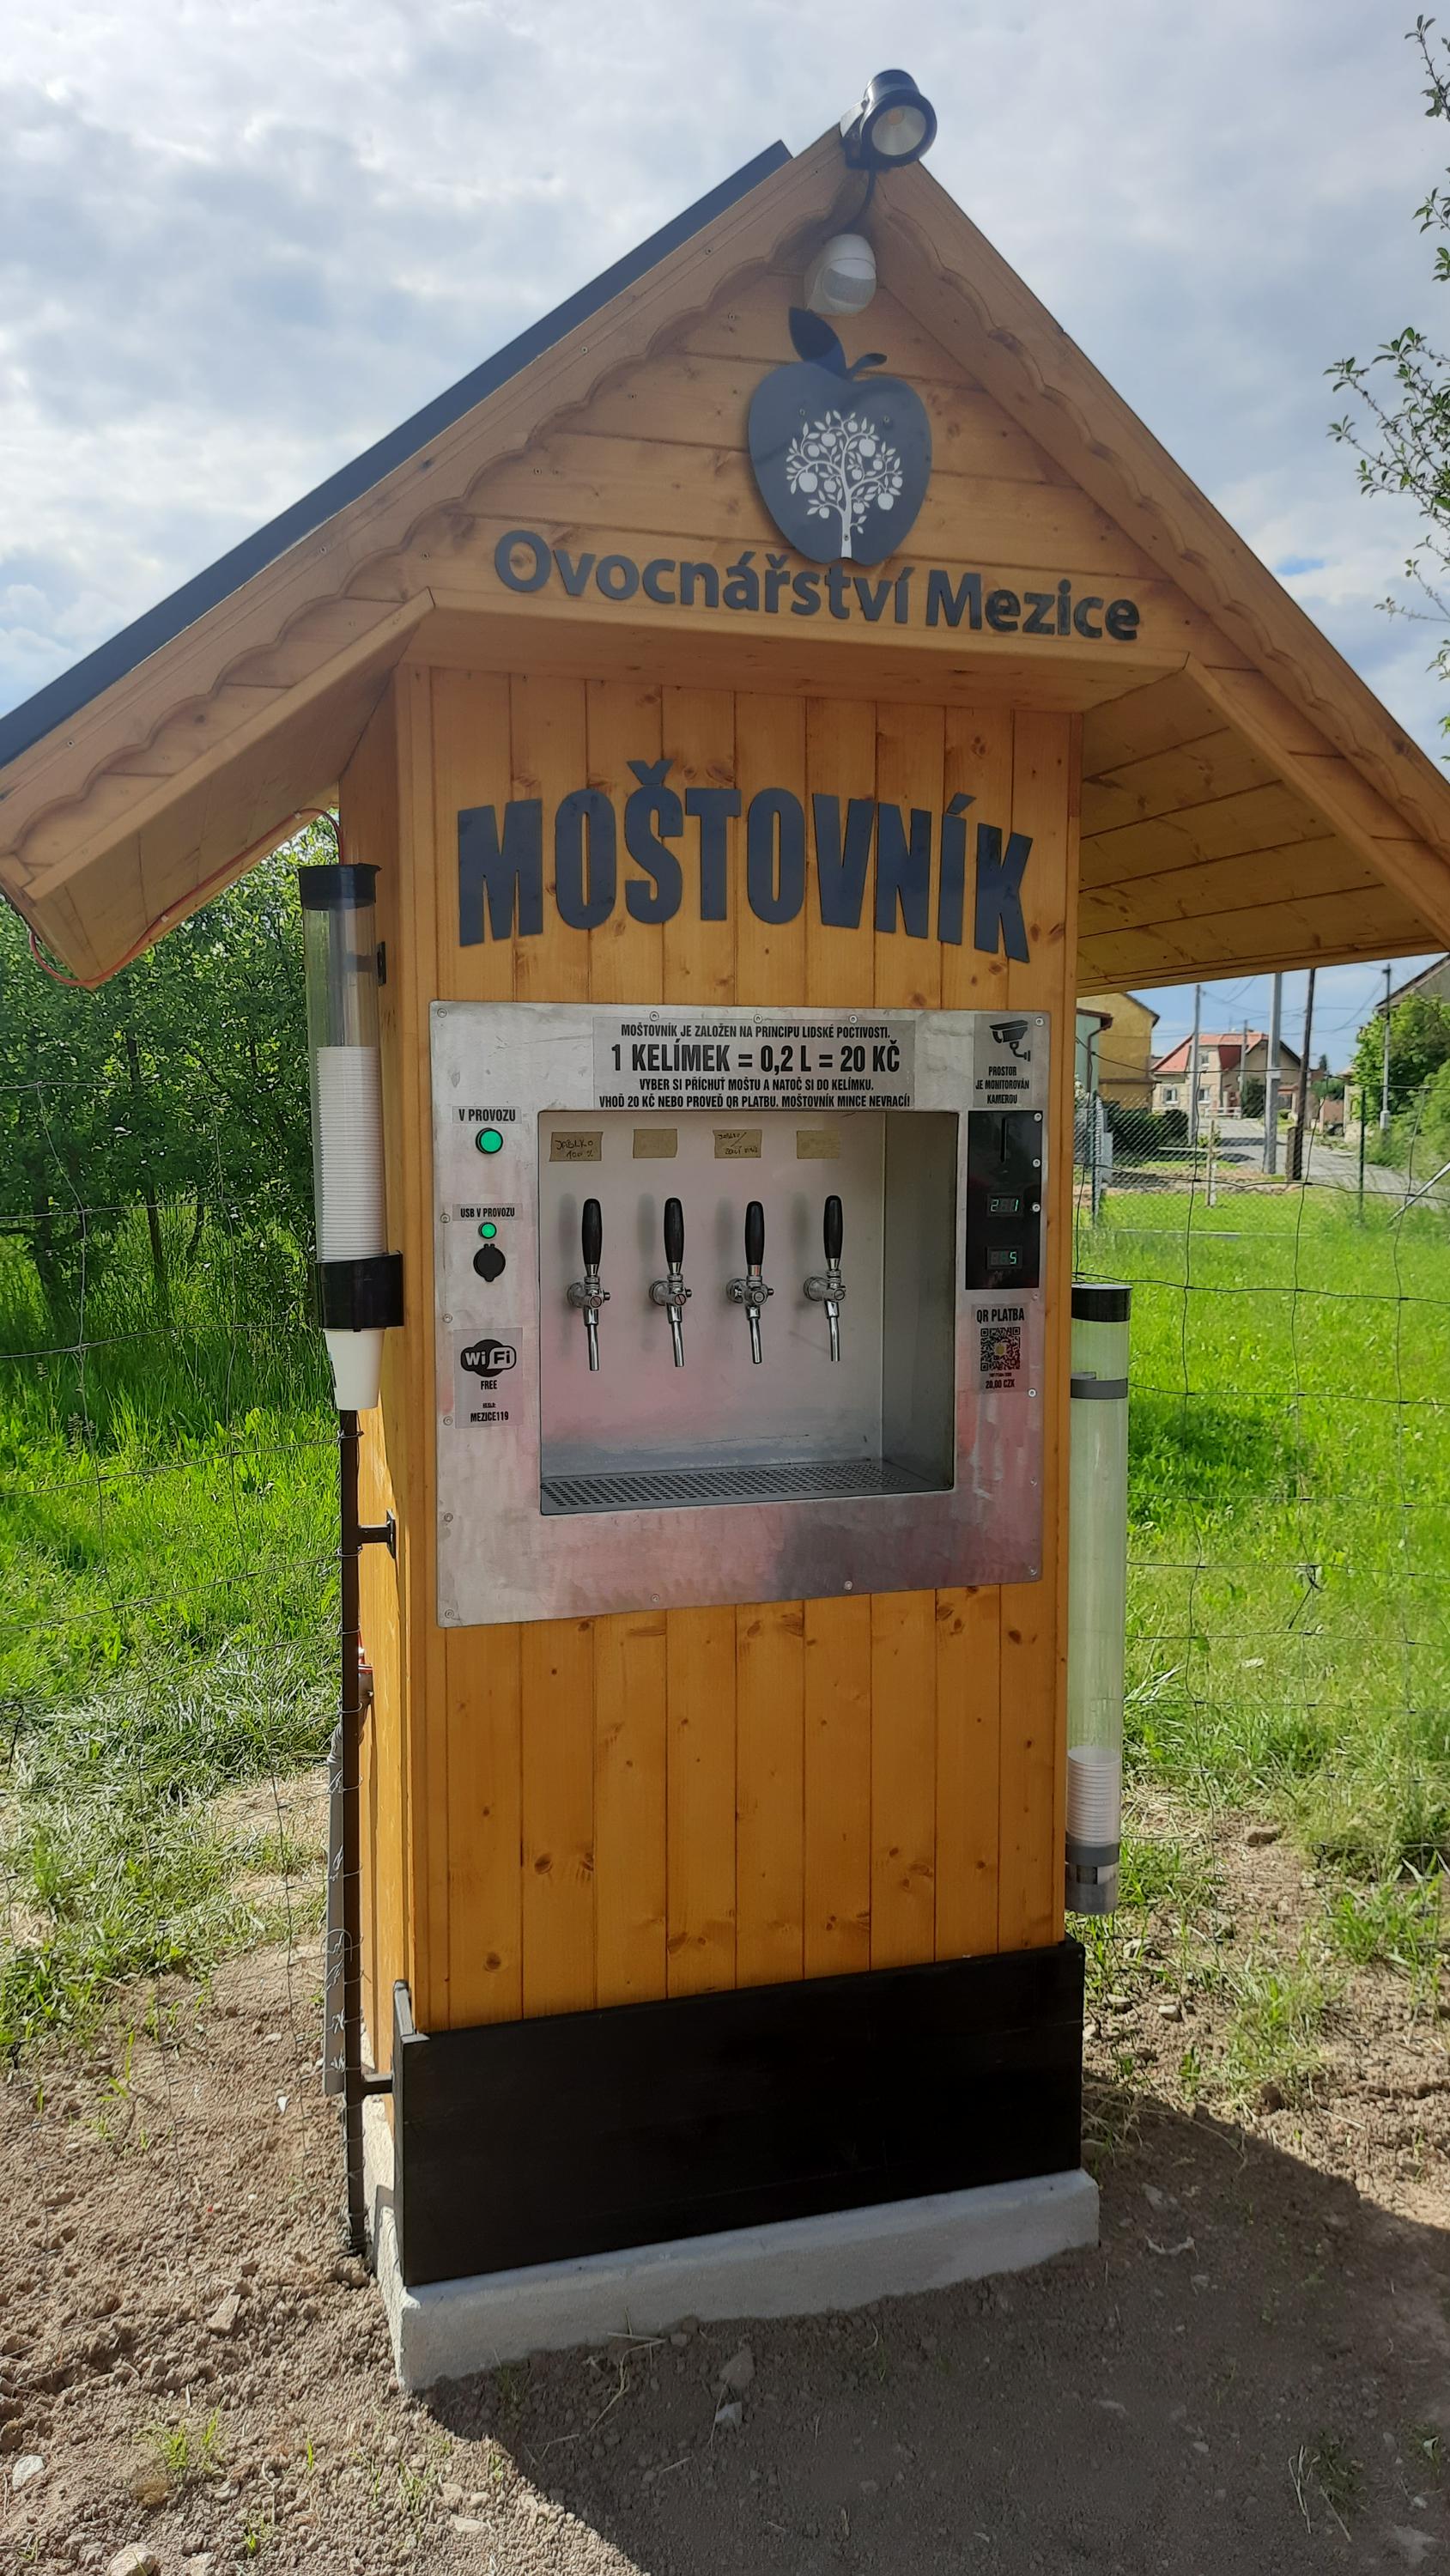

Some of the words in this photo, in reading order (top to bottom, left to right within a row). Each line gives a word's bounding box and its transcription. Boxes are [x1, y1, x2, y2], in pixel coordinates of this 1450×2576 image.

[494, 530, 915, 623] Ovocnářství
[925, 570, 1141, 641] Mezice
[458, 759, 1034, 963] MOŠTOVNÍK
[622, 1022, 677, 1036] MOŠTOVNÍK
[681, 1025, 691, 1036] JE
[695, 1024, 737, 1037] ZALOŽEN
[740, 1026, 752, 1037] NA
[755, 1026, 799, 1037] PRINCIPU
[803, 1024, 834, 1038] LIDSKÉ
[837, 1027, 890, 1038] POCTIVOSTI.
[611, 1044, 621, 1071] 1
[633, 1038, 730, 1072] KELÍMEK
[738, 1054, 752, 1067] =
[761, 1045, 792, 1075] 0,2
[800, 1045, 811, 1072] L
[819, 1054, 833, 1067] =
[840, 1046, 865, 1072] 20
[873, 1040, 900, 1072] KČ
[989, 1066, 1016, 1076] PROSTOR
[640, 1078, 670, 1091] VYBER
[673, 1079, 682, 1091] SI
[685, 1077, 725, 1091] PŘÍCHUŤ
[728, 1077, 761, 1091] MOŠTU
[763, 1079, 769, 1091] A
[773, 1077, 802, 1091] NATOČ
[805, 1079, 814, 1091] SI
[817, 1079, 829, 1091] DO
[832, 1077, 874, 1091] KELÍMKU.
[975, 1080, 983, 1090] JE
[985, 1078, 1029, 1090] MONITOROVÁN
[599, 1093, 624, 1108] VHOĎ
[628, 1096, 639, 1107] 20
[642, 1093, 654, 1107] KČ
[658, 1096, 683, 1107] NEBO
[687, 1093, 723, 1107] PROVEĎ
[726, 1097, 739, 1109] QR
[742, 1096, 779, 1108] PLATBU.
[782, 1093, 834, 1107] MOŠTOVNÍK
[837, 1096, 866, 1107] MINCE
[870, 1093, 910, 1107] NEVRACÍ!
[987, 1095, 1017, 1103] KAMEROU
[458, 1109, 464, 1121] V
[469, 1109, 515, 1121] PROVOZU
[460, 1208, 474, 1218] USB
[476, 1208, 481, 1218] V
[482, 1207, 515, 1217] PROVOZU
[977, 1309, 988, 1323] QR
[992, 1308, 1024, 1321] PLATBA
[481, 1380, 497, 1390] FREE
[1004, 1379, 1015, 1388] CZK
[470, 1412, 509, 1422] MEZICE119
